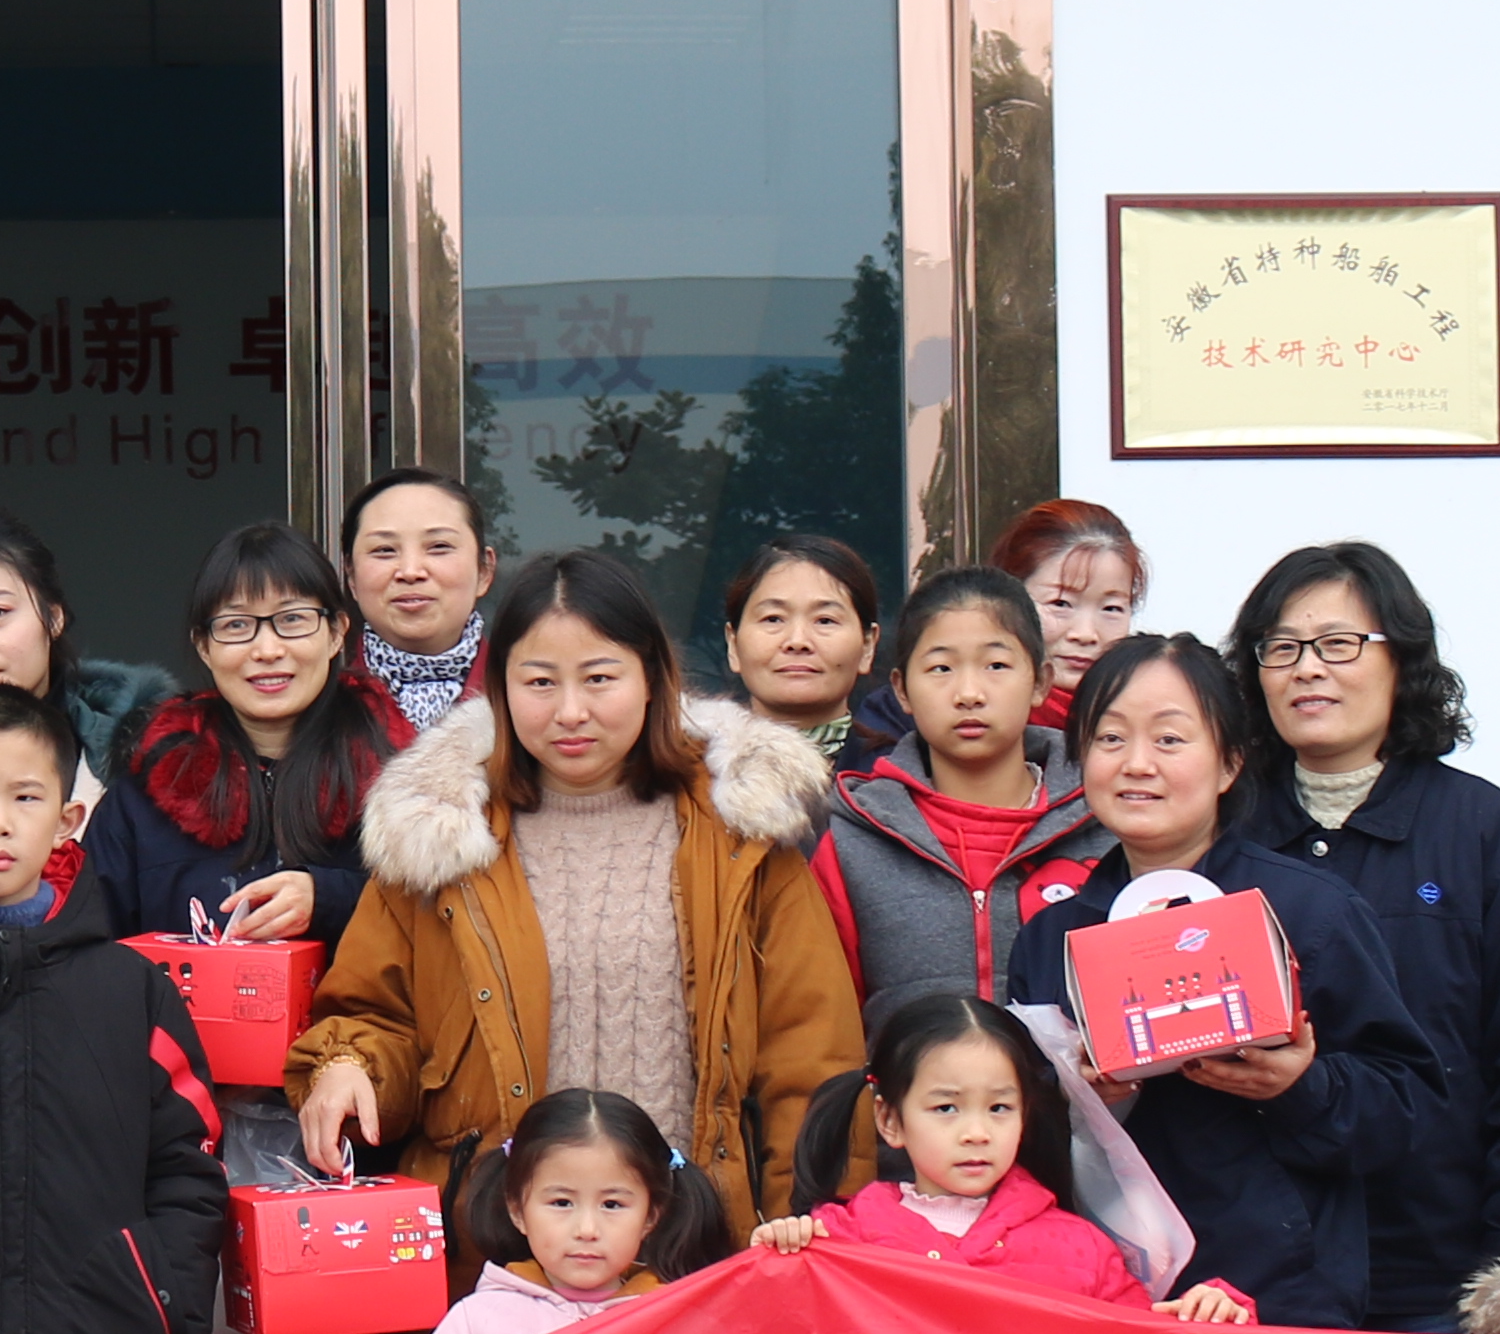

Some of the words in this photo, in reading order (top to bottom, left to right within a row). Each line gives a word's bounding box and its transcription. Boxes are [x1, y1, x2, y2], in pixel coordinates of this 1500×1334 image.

[1162, 236, 1459, 342] 安徽省特种船舶工程
[229, 294, 655, 393] 卓高效
[1201, 334, 1422, 368] 技术研究中心
[110, 413, 262, 480] High
